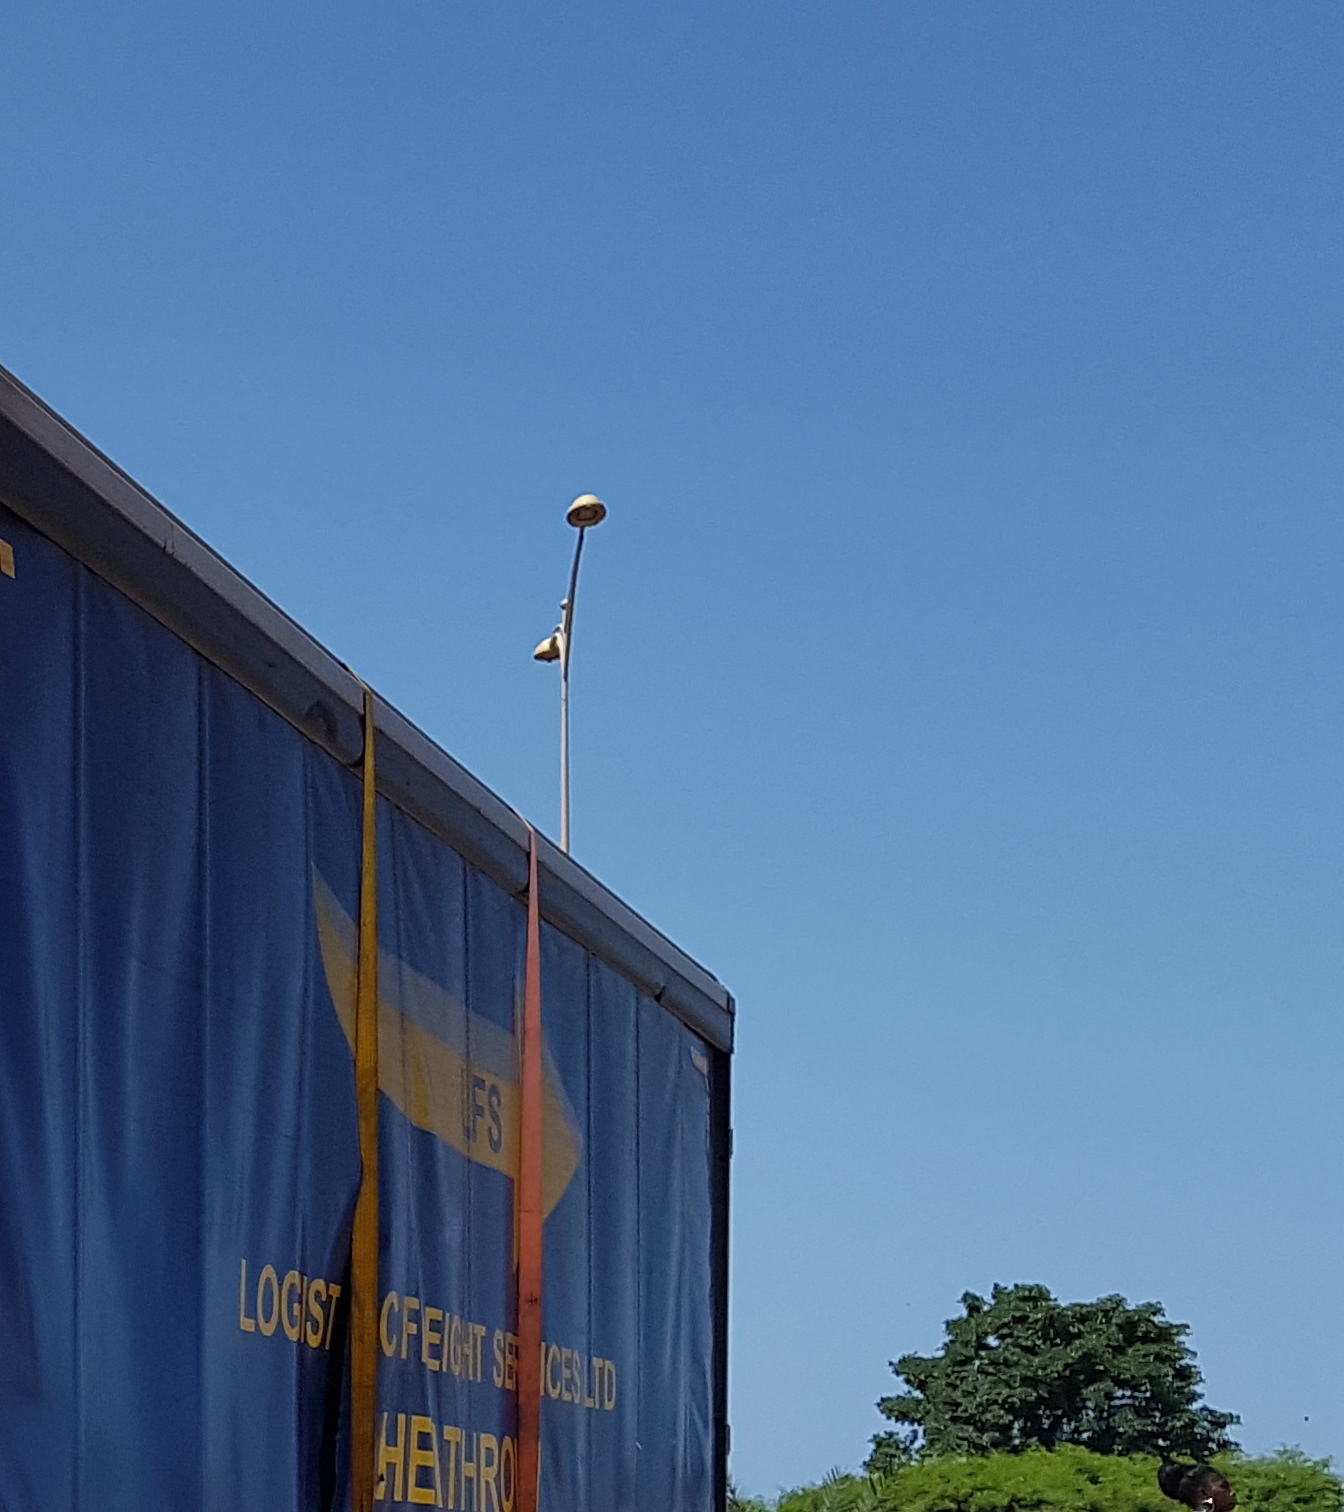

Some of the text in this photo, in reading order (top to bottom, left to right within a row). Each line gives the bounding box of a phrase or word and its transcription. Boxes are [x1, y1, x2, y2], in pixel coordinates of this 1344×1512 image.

[464, 1076, 502, 1153] FS
[239, 1257, 399, 1359] LOGISTC
[583, 1354, 617, 1412] LTD
